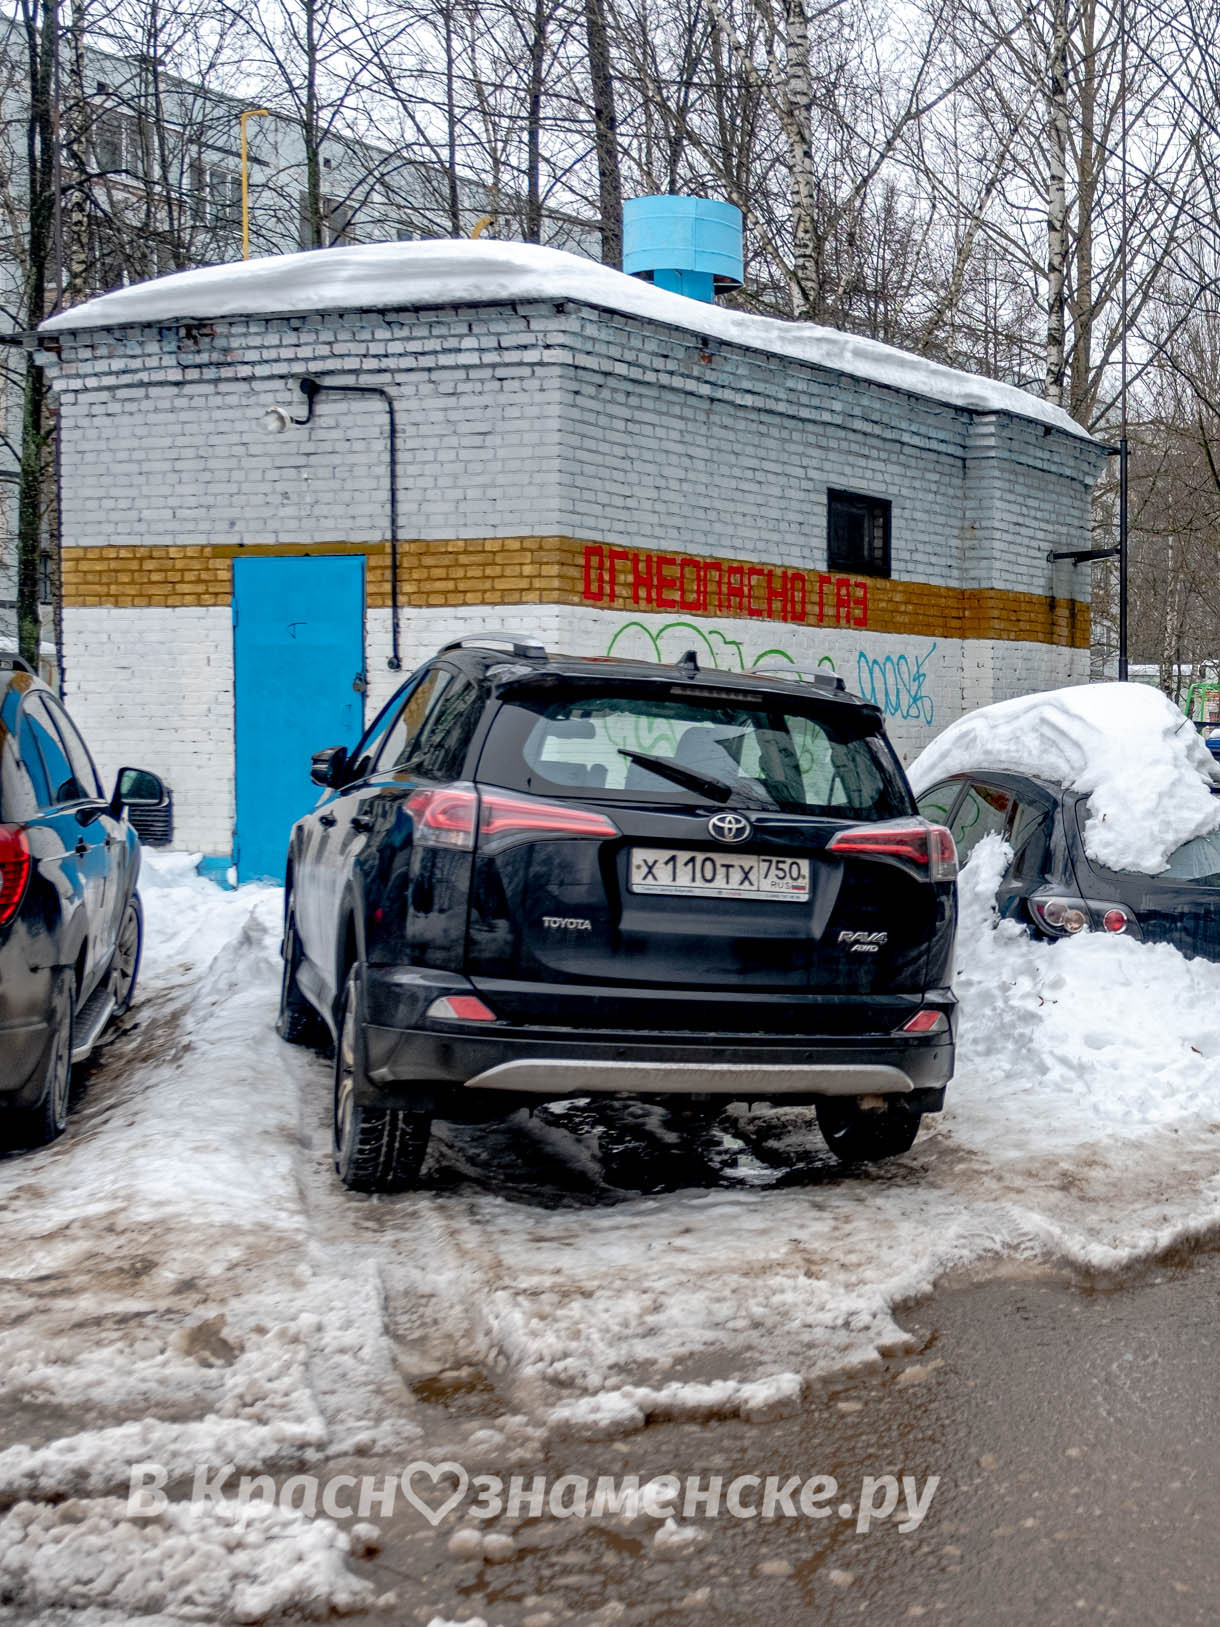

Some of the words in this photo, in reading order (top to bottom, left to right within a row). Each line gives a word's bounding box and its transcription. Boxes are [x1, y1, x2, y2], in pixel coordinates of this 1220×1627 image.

[583, 545, 806, 622] ОГНЕОПАСНО
[818, 573, 867, 627] ГАЗ
[761, 858, 801, 881] 750
[770, 880, 791, 889] RUS
[542, 916, 592, 930] TOYOTA
[838, 931, 888, 945] RAV4
[850, 944, 879, 952] AWD
